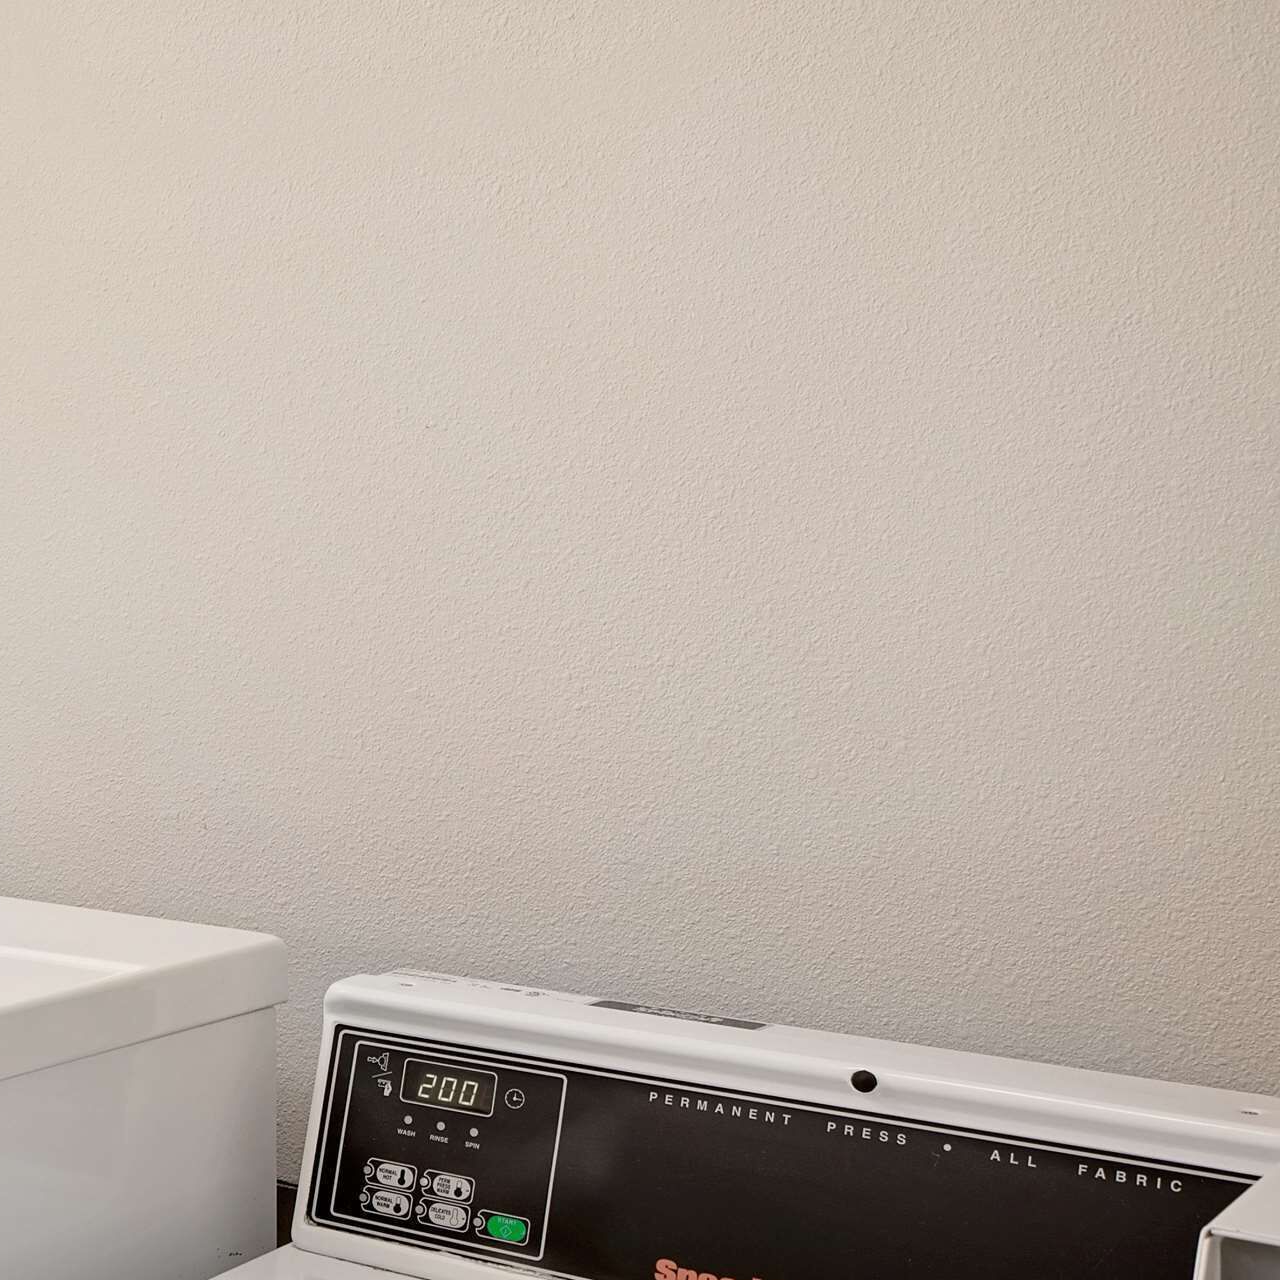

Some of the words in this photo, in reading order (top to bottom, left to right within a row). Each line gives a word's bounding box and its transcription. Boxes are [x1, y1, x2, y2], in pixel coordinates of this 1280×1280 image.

[418, 1074, 478, 1106] 200
[397, 1128, 416, 1137] WASH
[430, 1135, 449, 1144] RINSE
[649, 1092, 791, 1125] PERMANENT
[827, 1121, 908, 1146] PRESS
[990, 1149, 1038, 1168] ALL
[1077, 1164, 1183, 1192] FABRIC
[465, 1141, 480, 1150] SPIN
[379, 1167, 397, 1176] NORMAL
[374, 1195, 393, 1204] NORMAL
[431, 1207, 451, 1216] DELICATES
